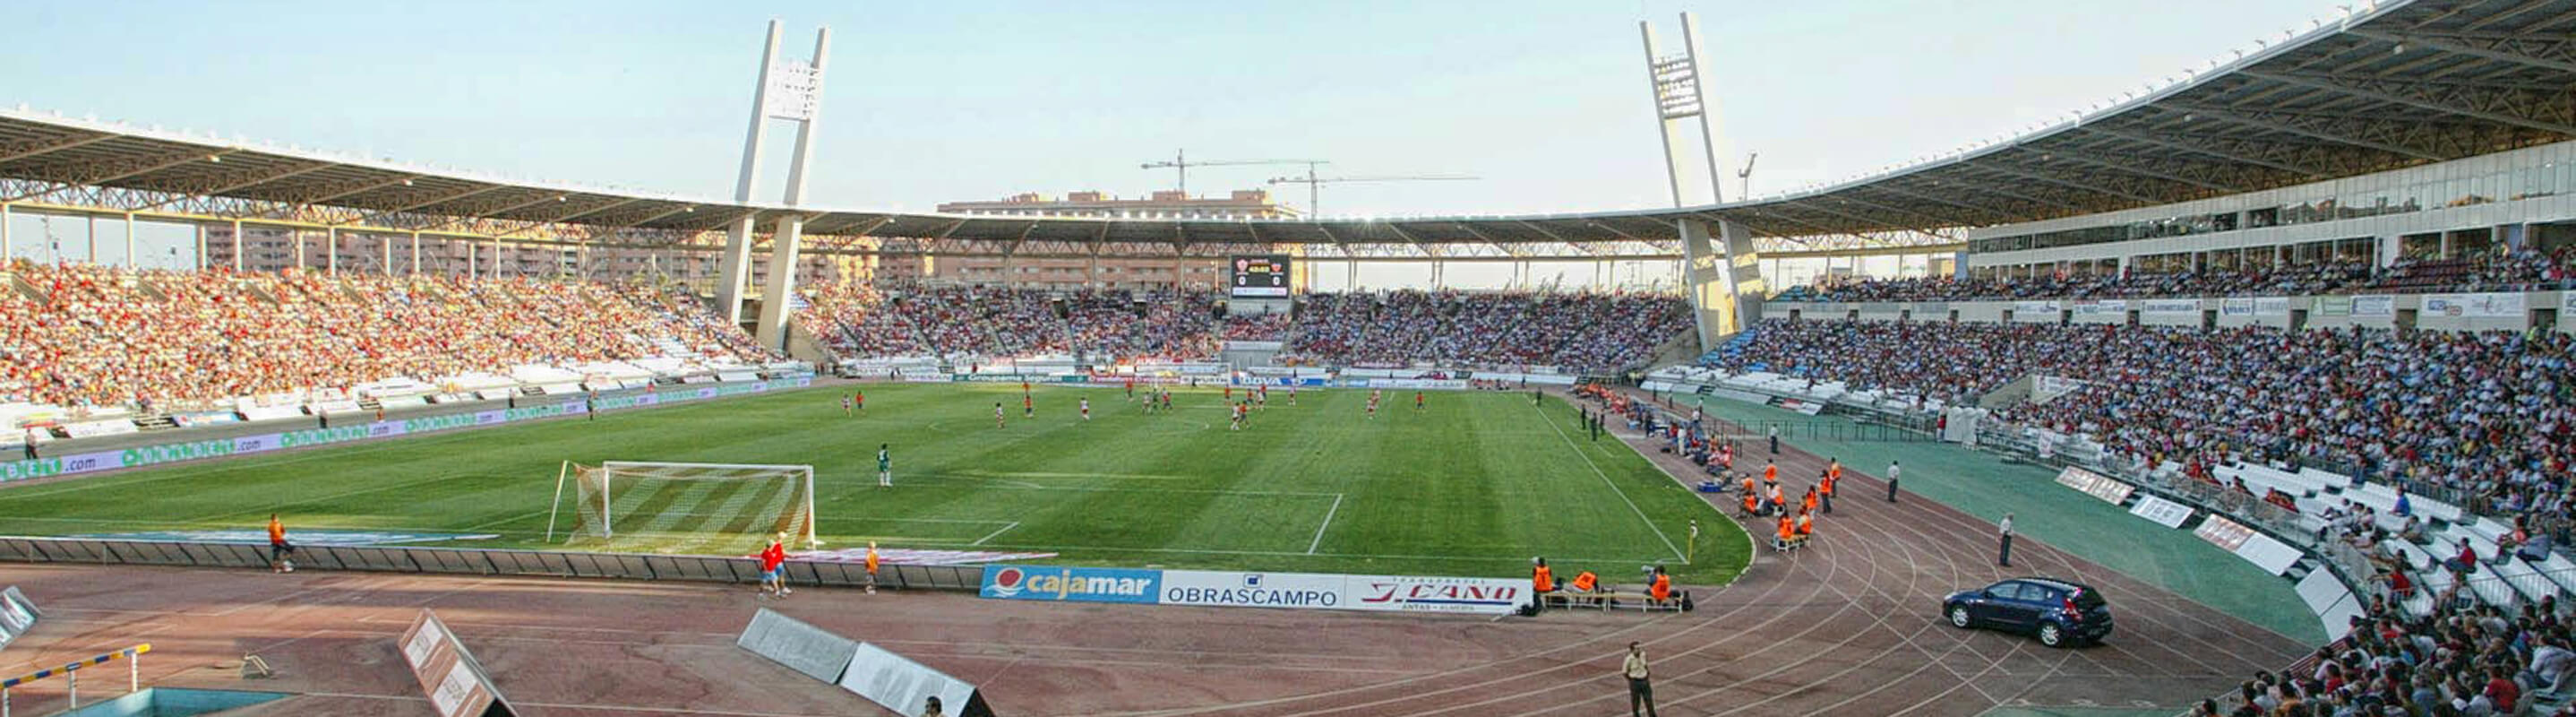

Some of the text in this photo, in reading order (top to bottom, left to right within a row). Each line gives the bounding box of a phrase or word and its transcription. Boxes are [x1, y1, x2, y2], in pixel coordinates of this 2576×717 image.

[1239, 276, 1246, 285] 0
[1273, 276, 1280, 285] 0
[967, 373, 1062, 384] Groupama Seguros
[1026, 570, 1152, 600] cajamar
[1409, 583, 1516, 600] CANO
[1168, 587, 1336, 607] OBRASCAMPO
